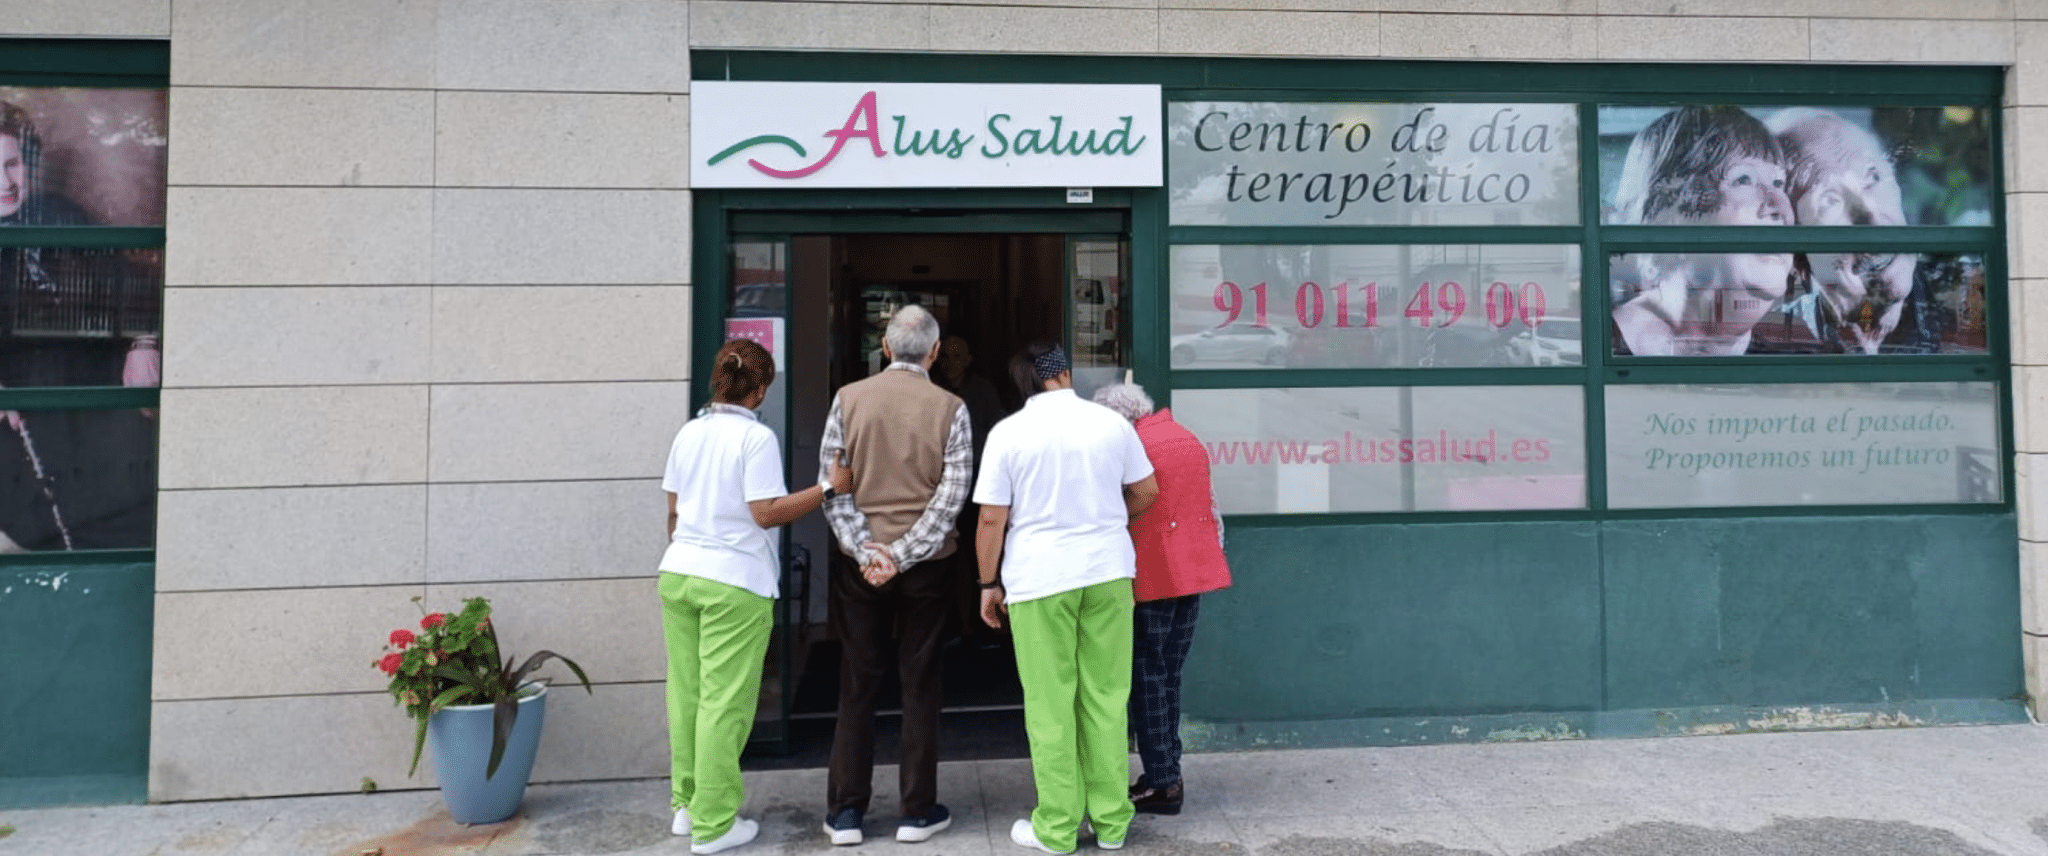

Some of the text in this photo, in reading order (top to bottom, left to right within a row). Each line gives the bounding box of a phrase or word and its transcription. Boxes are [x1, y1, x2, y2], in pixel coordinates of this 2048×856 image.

[821, 90, 1146, 159] Alus Salud
[1194, 106, 1553, 154] Centro de día
[1225, 161, 1530, 220] terapéutico
[1213, 281, 1546, 329] 91 011 49 00
[1206, 430, 1551, 466] www.alussalud.es
[1643, 406, 1955, 442] Nos importa el pasado.
[1644, 442, 1950, 476] Proponemos un futuro
